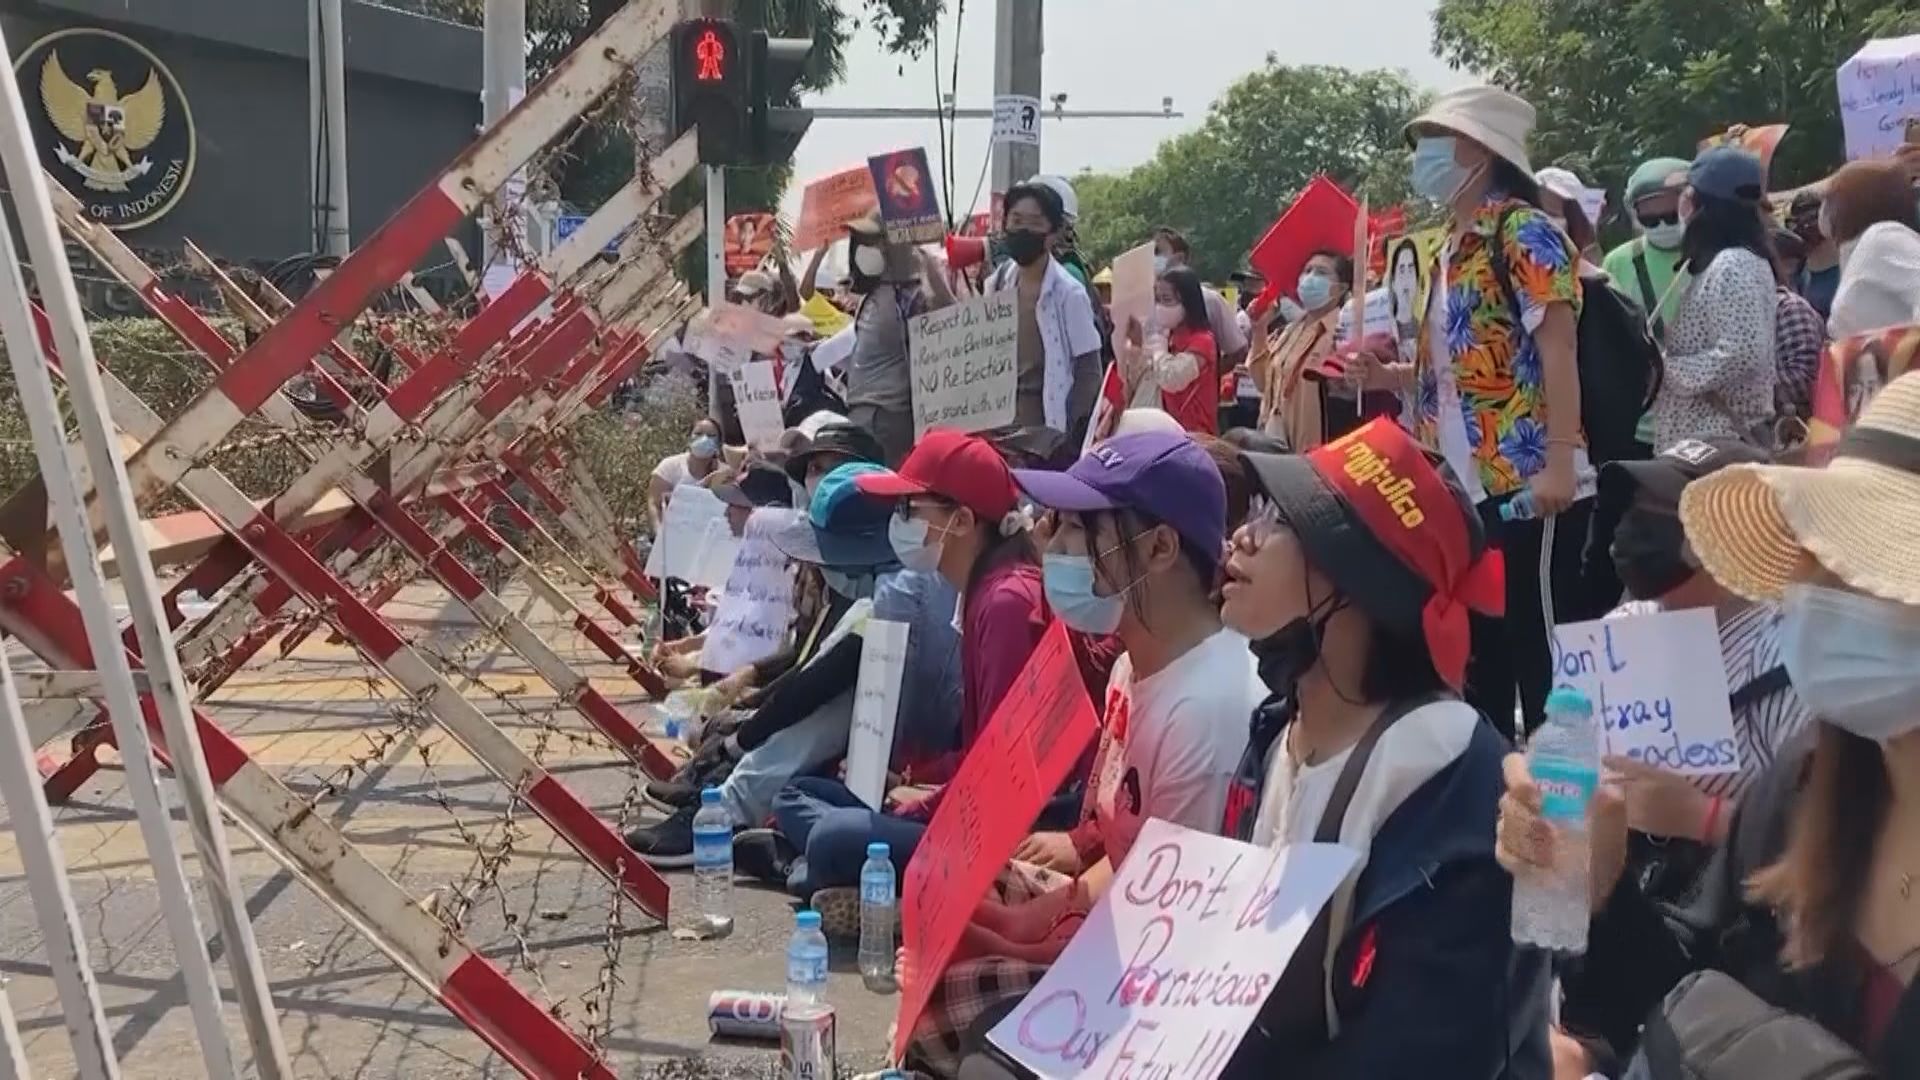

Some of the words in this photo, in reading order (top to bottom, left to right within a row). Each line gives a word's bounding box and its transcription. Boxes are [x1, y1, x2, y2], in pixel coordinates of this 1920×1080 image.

[90, 203, 113, 218] OF
[118, 158, 184, 218] INDONESIA
[1125, 843, 1242, 922] Don't
[1234, 850, 1281, 932] be
